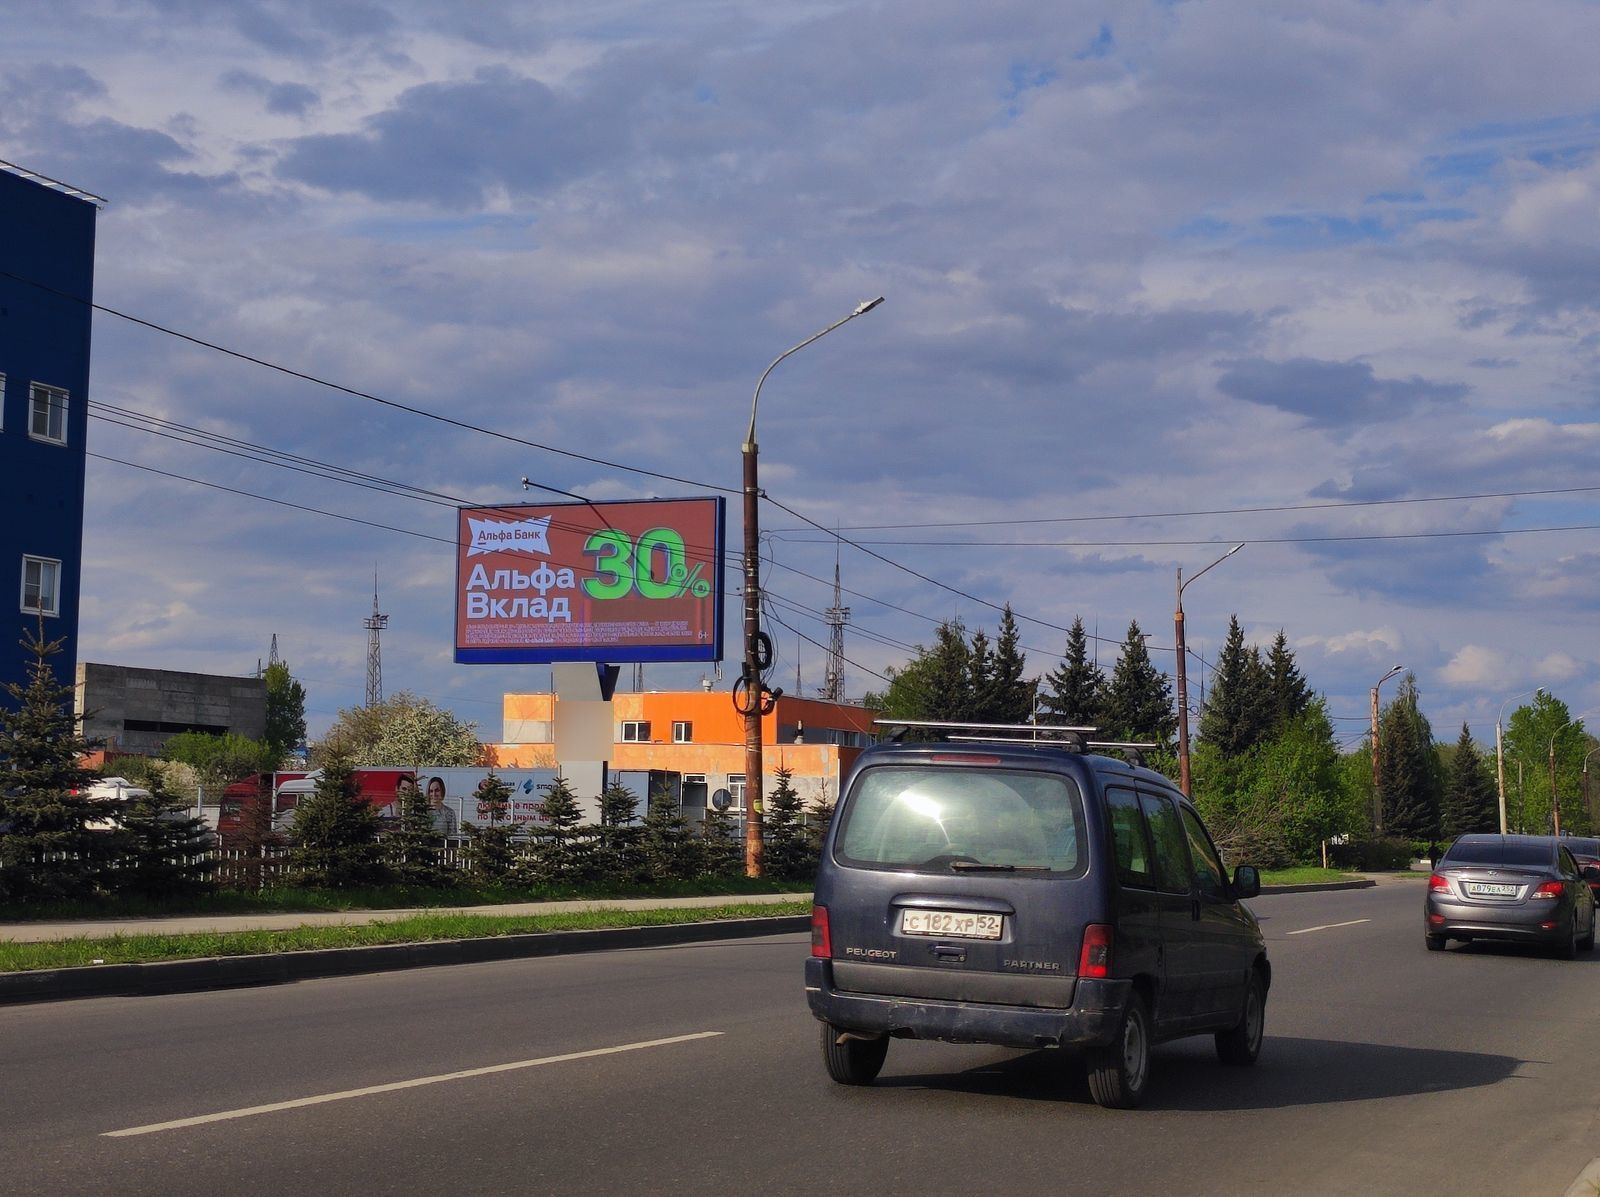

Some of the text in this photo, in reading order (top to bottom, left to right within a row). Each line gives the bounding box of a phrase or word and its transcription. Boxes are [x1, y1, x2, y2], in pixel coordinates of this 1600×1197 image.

[478, 529, 541, 544] Альфа Банк
[466, 561, 576, 597] Альфа
[466, 592, 572, 623] Вклад
[845, 947, 898, 960] PEUGEOT
[1003, 959, 1062, 971] PARTNER
